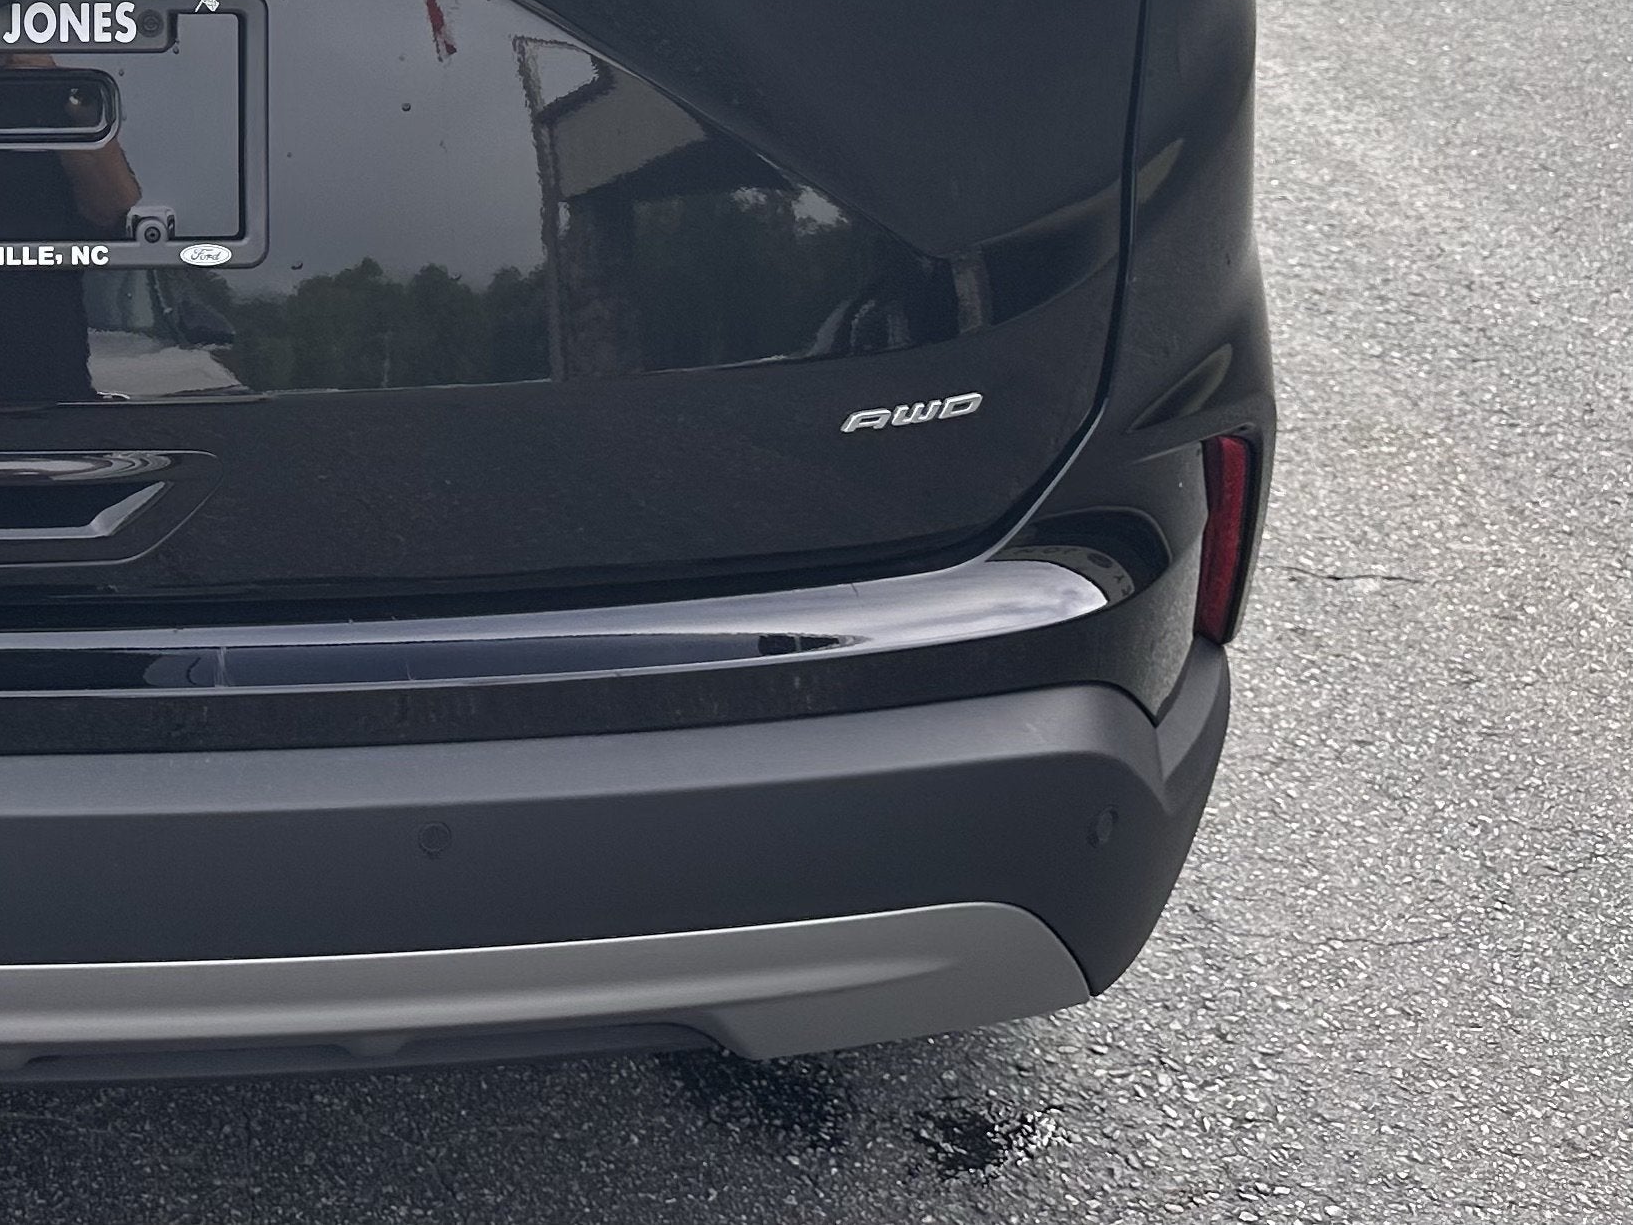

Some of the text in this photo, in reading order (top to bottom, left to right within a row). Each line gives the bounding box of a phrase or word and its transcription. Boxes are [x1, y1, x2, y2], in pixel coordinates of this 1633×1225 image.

[2, 1, 138, 44] JONES
[70, 245, 109, 266] NC
[840, 392, 983, 433] AWD
